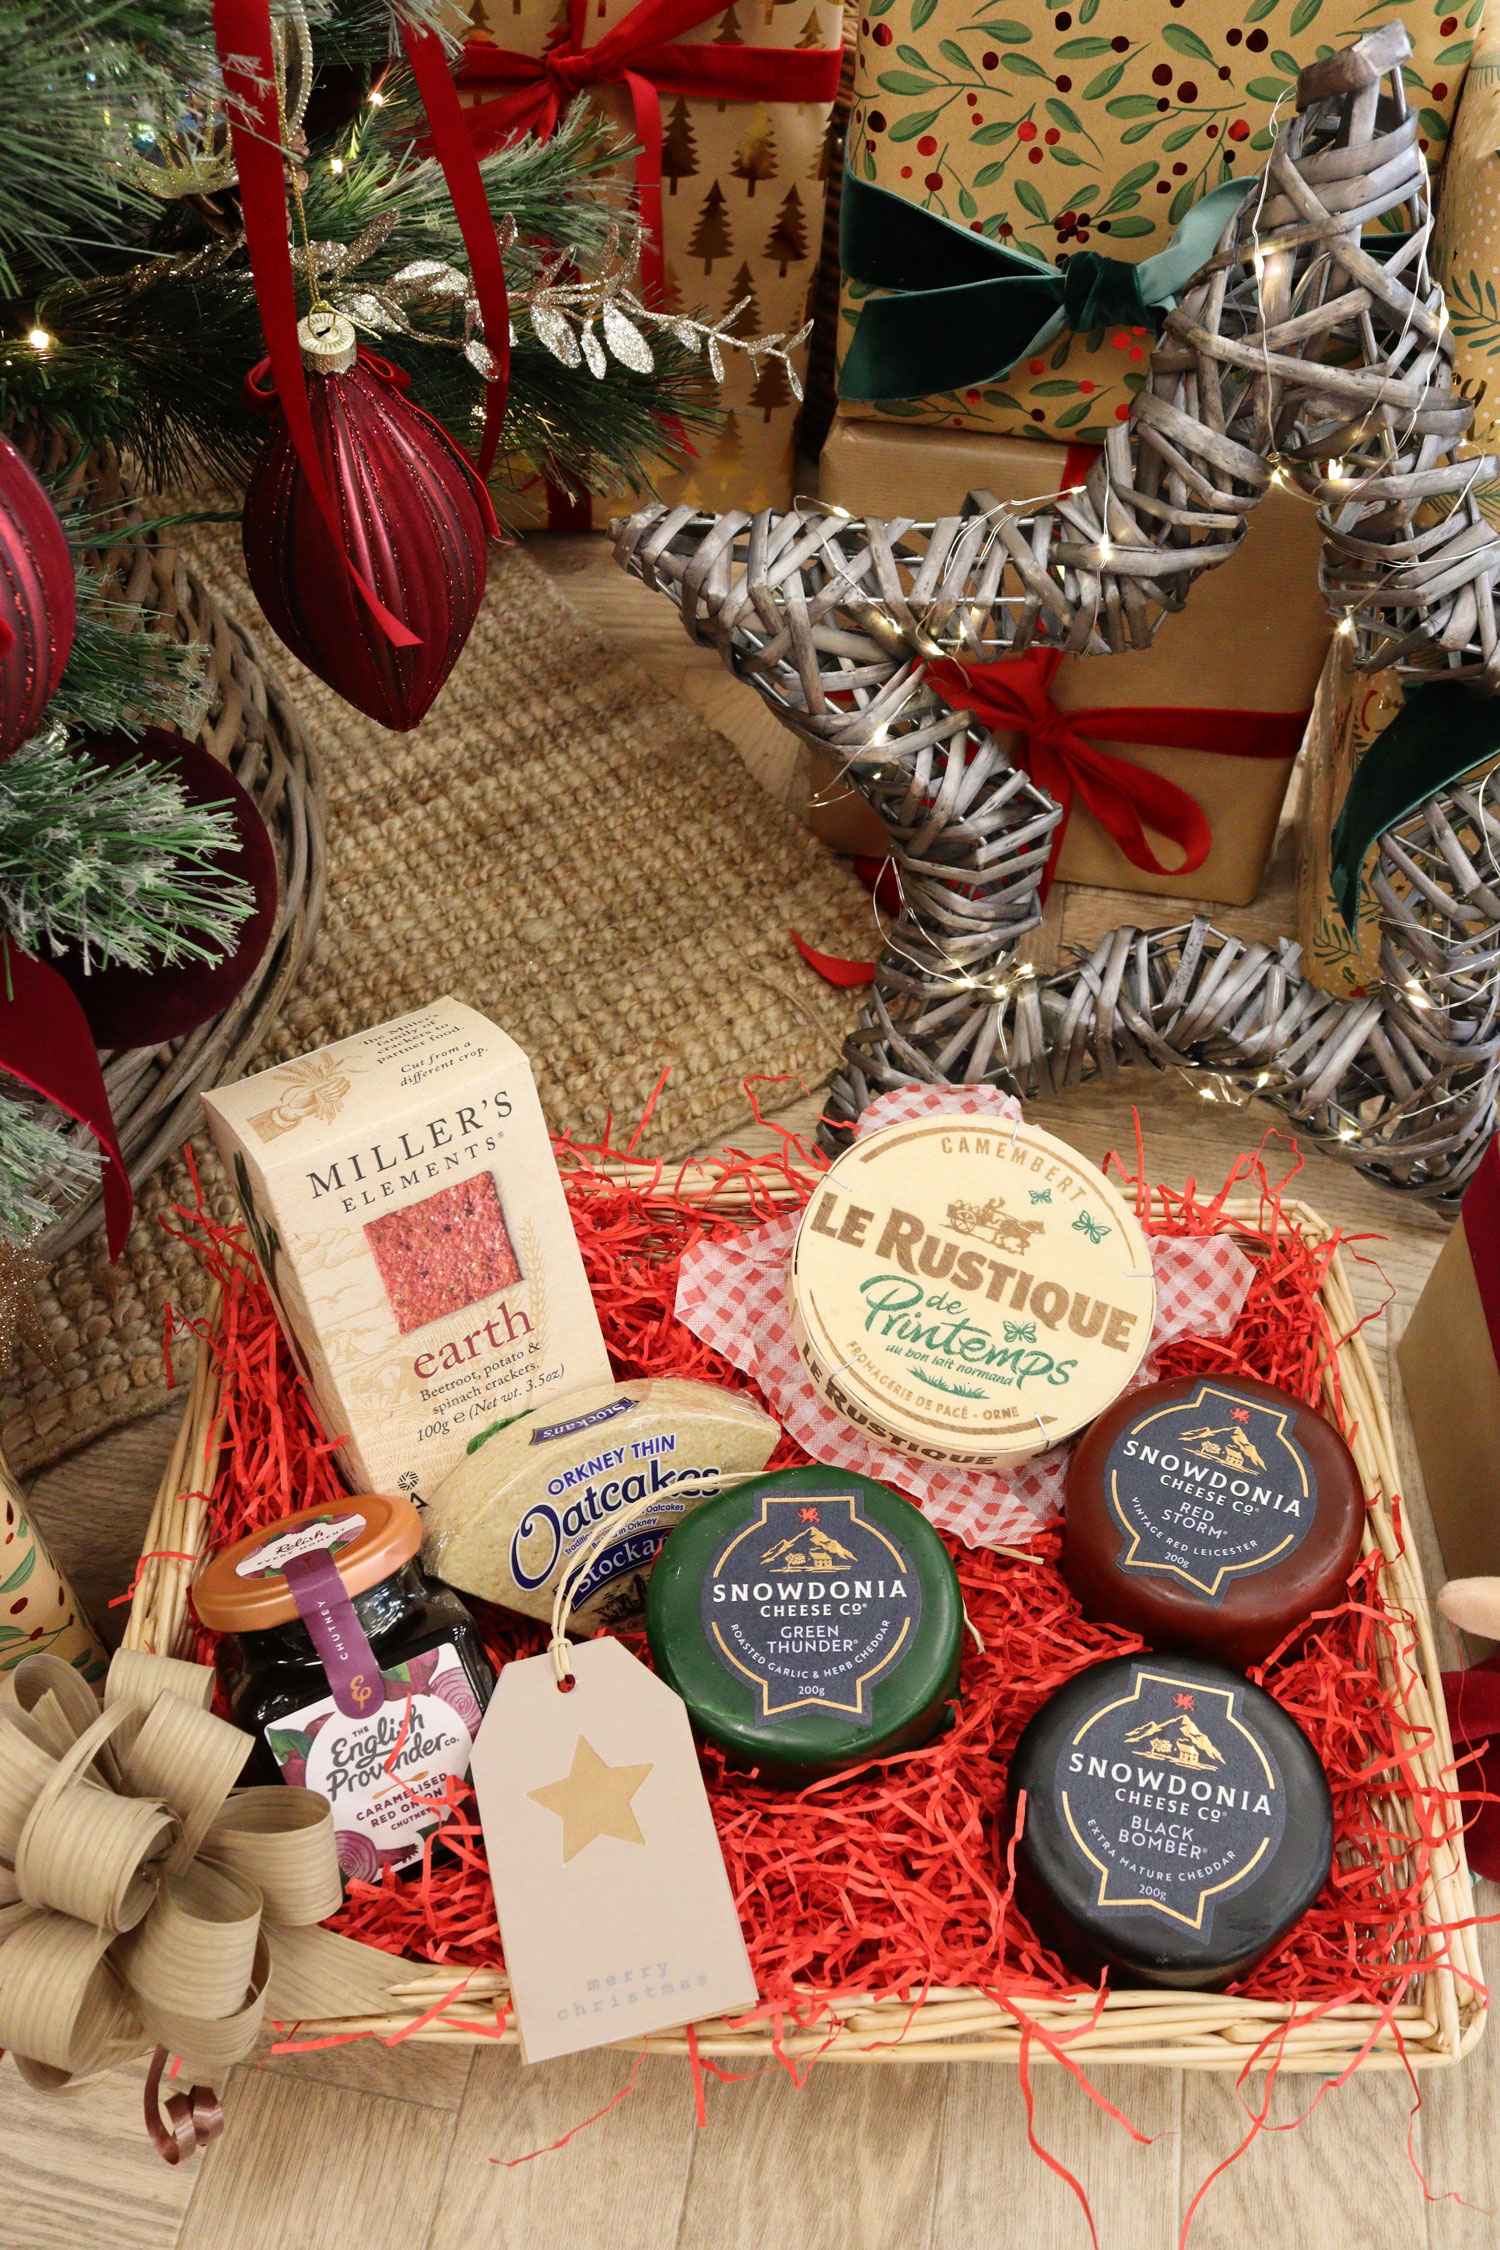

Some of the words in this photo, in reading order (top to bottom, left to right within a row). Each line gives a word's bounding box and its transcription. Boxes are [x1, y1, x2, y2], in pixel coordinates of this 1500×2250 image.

[376, 1040, 426, 1064] partner
[429, 1025, 465, 1041] food.
[377, 1028, 418, 1047] family
[422, 1019, 437, 1029] of
[377, 1031, 432, 1054] crackers
[435, 1023, 449, 1031] to
[400, 1060, 425, 1073] Cut
[428, 1046, 459, 1065] from
[400, 1059, 455, 1087] different
[458, 1047, 488, 1062] crop.
[305, 1090, 513, 1199] MILLER'S
[940, 1136, 1088, 1203] CAMEMBERT
[809, 1191, 875, 1249] LE
[874, 1207, 1139, 1353] RUSTIQUE
[925, 1291, 968, 1315] de
[413, 1300, 535, 1379] earth
[419, 1371, 482, 1402] Beetroot,
[483, 1350, 525, 1378] potato
[528, 1341, 542, 1354] &
[845, 1340, 912, 1402] FROMAGERIE
[917, 1396, 933, 1411] DE
[936, 1402, 968, 1420] PACÉ
[982, 1406, 1020, 1421] ORNE
[885, 1343, 901, 1355] au
[906, 1347, 929, 1364] bon
[931, 1354, 954, 1371] lait
[956, 1363, 1015, 1387] normand
[417, 1420, 451, 1443] 100g
[469, 1398, 498, 1420] (Net
[501, 1386, 522, 1403] wt.
[525, 1363, 566, 1393] 3.5oz)
[432, 1386, 482, 1417] spinach
[485, 1361, 541, 1392] crackers.
[802, 1342, 823, 1384] LE
[825, 1375, 998, 1466] RUSTIQUE
[547, 1446, 625, 1495] ORKNEY
[630, 1434, 676, 1459] THIN
[1122, 1439, 1301, 1518] SNOWDONIA
[646, 1502, 684, 1514] Oatcakes
[1159, 1474, 1227, 1507] CHEESE
[510, 1459, 722, 1591] Oatcakes
[627, 1517, 658, 1531] Orkney
[1131, 1496, 1164, 1539] VINTAGE
[1165, 1537, 1189, 1552] RED
[1193, 1539, 1259, 1557] LEICESTER
[1179, 1501, 1215, 1522] RED
[275, 1530, 324, 1555] Relish
[1164, 1551, 1191, 1569] 200g
[712, 1579, 908, 1603] SNOWDONIA
[759, 1604, 832, 1617] CHEESE
[317, 1600, 348, 1661] CHUTNEY
[730, 1623, 767, 1665] ROASTED
[767, 1661, 809, 1679] GARLIC
[812, 1670, 820, 1679] &
[823, 1661, 854, 1678] HERB
[855, 1619, 892, 1664] CHEDDAR
[780, 1624, 839, 1639] GREEN
[798, 1685, 826, 1697] 200g
[352, 1725, 370, 1738] THE
[325, 1732, 447, 1802] Provnder
[1068, 1752, 1272, 1817] SNOWDONIA
[356, 1772, 448, 1821] CARAMELISED
[1114, 1788, 1190, 1817] CHEESE
[370, 1810, 397, 1829] RED
[390, 1807, 432, 1831] CHUTNEY
[1130, 1815, 1195, 1843] BLACK
[1087, 1819, 1116, 1858] EXTRA
[1118, 1856, 1173, 1882] MATURE
[1178, 1850, 1238, 1882] CHEDDAR
[1138, 1883, 1167, 1902] 200g
[586, 1960, 670, 1992] merry
[556, 1973, 709, 2022] christmas
